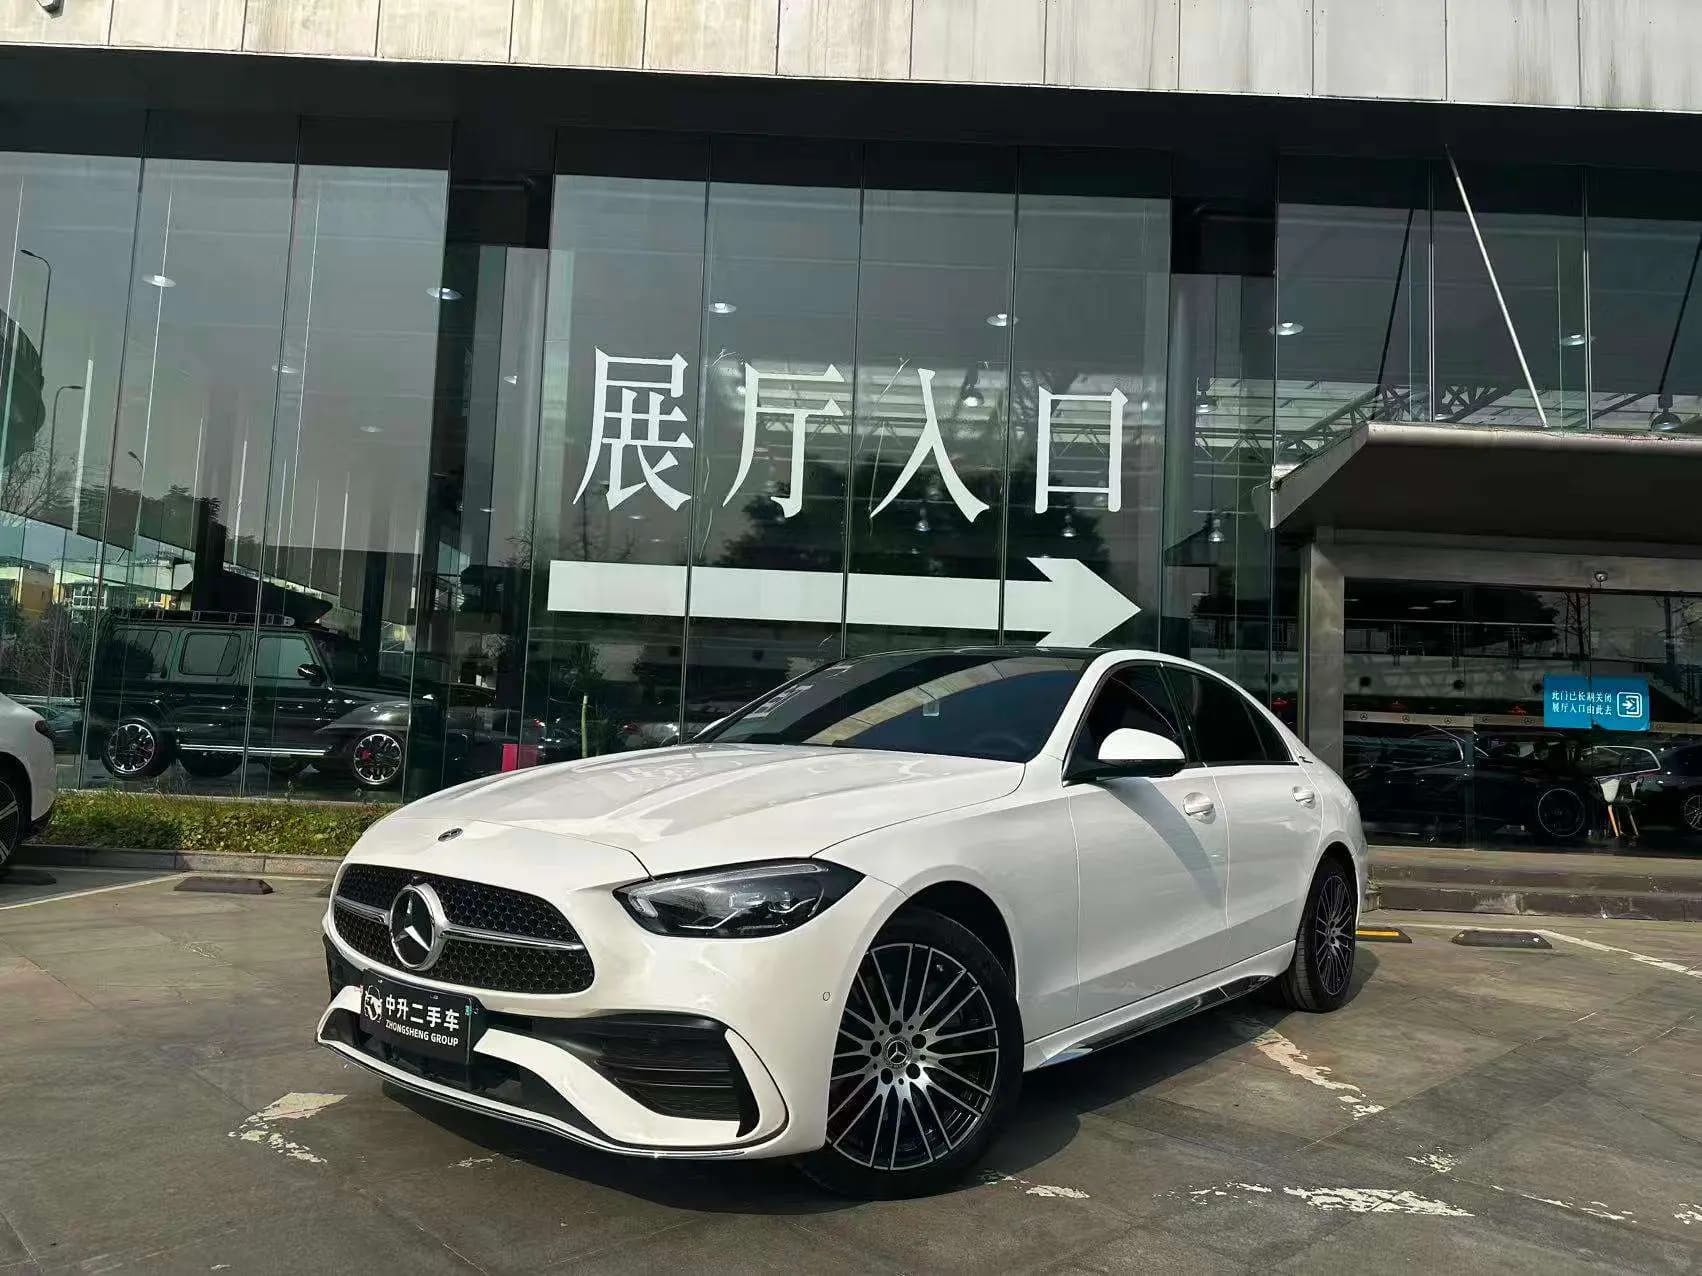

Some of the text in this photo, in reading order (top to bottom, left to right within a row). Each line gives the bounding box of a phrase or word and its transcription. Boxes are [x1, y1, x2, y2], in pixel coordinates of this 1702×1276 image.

[573, 345, 1129, 523] 展厅入口
[1551, 690, 1612, 703] 此门已长期关闭
[1551, 702, 1612, 716] 展厅入口由此去
[385, 994, 460, 1032] 中升二手车
[385, 1019, 459, 1047] ZHONGSHENG GROUP
